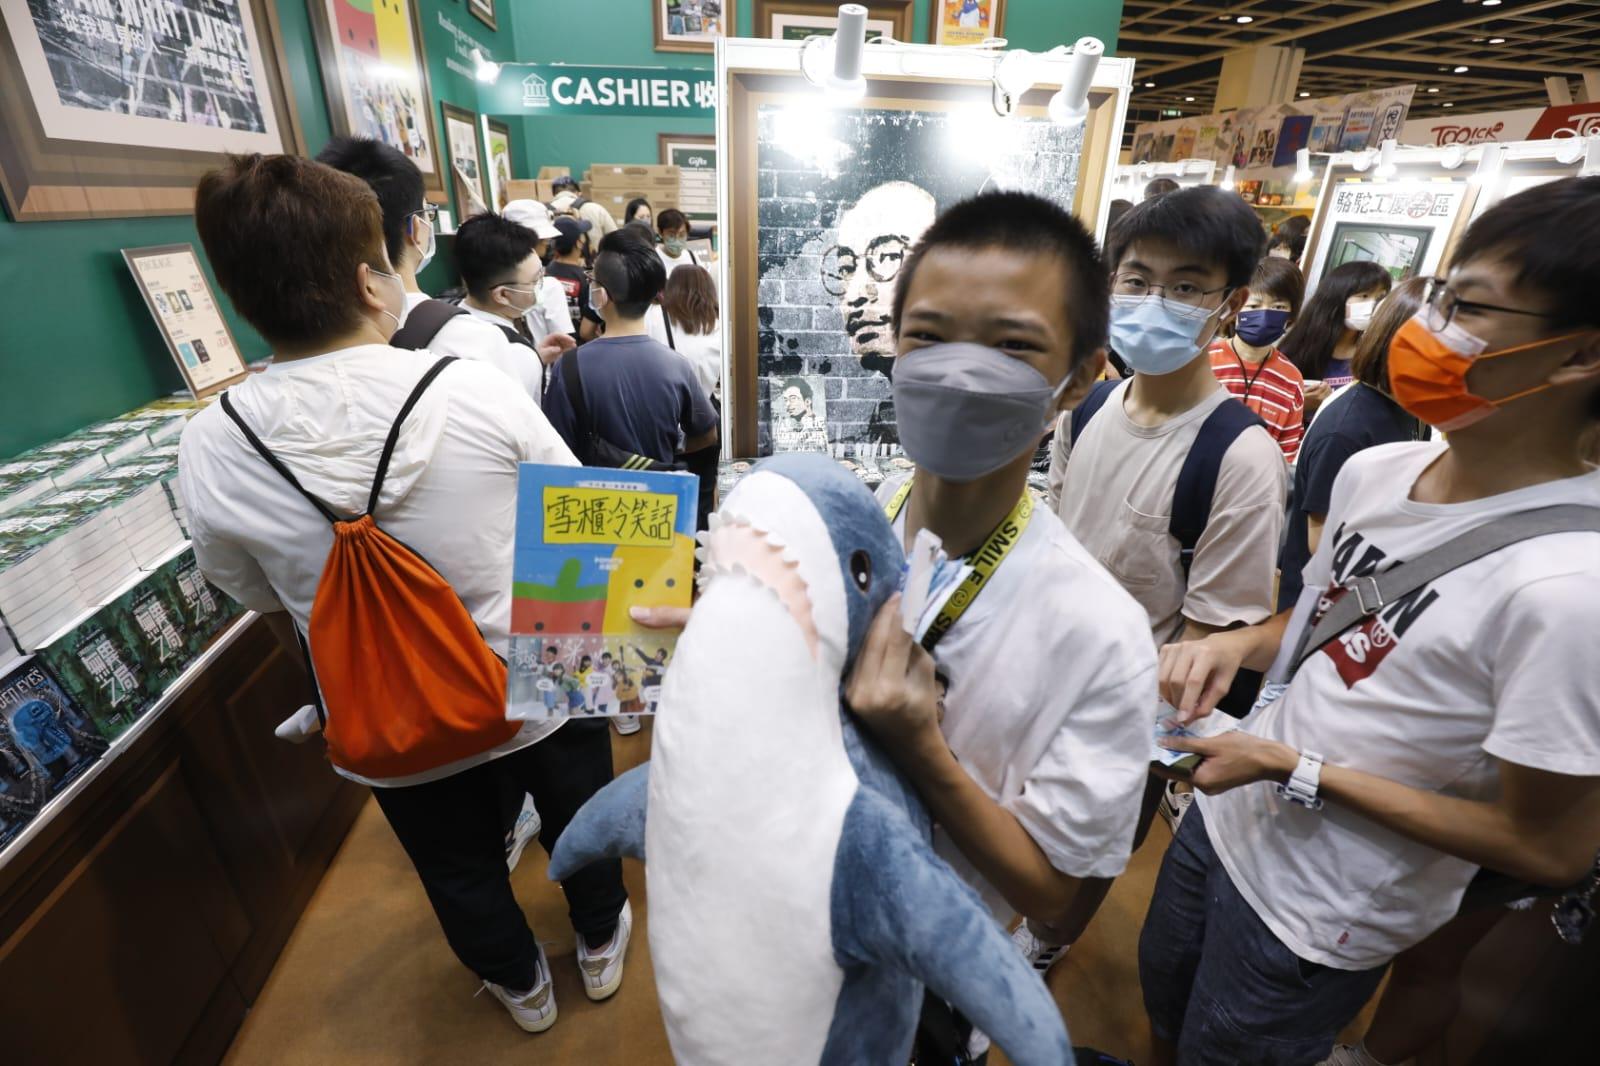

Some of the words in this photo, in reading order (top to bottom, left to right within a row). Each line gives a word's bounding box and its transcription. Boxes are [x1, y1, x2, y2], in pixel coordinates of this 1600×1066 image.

[551, 76, 691, 107] CASHIER
[688, 156, 708, 168] Gifts
[547, 495, 674, 540] 雪櫃冷笑話
[966, 521, 1018, 586] SMILE
[18, 668, 44, 695] EYES
